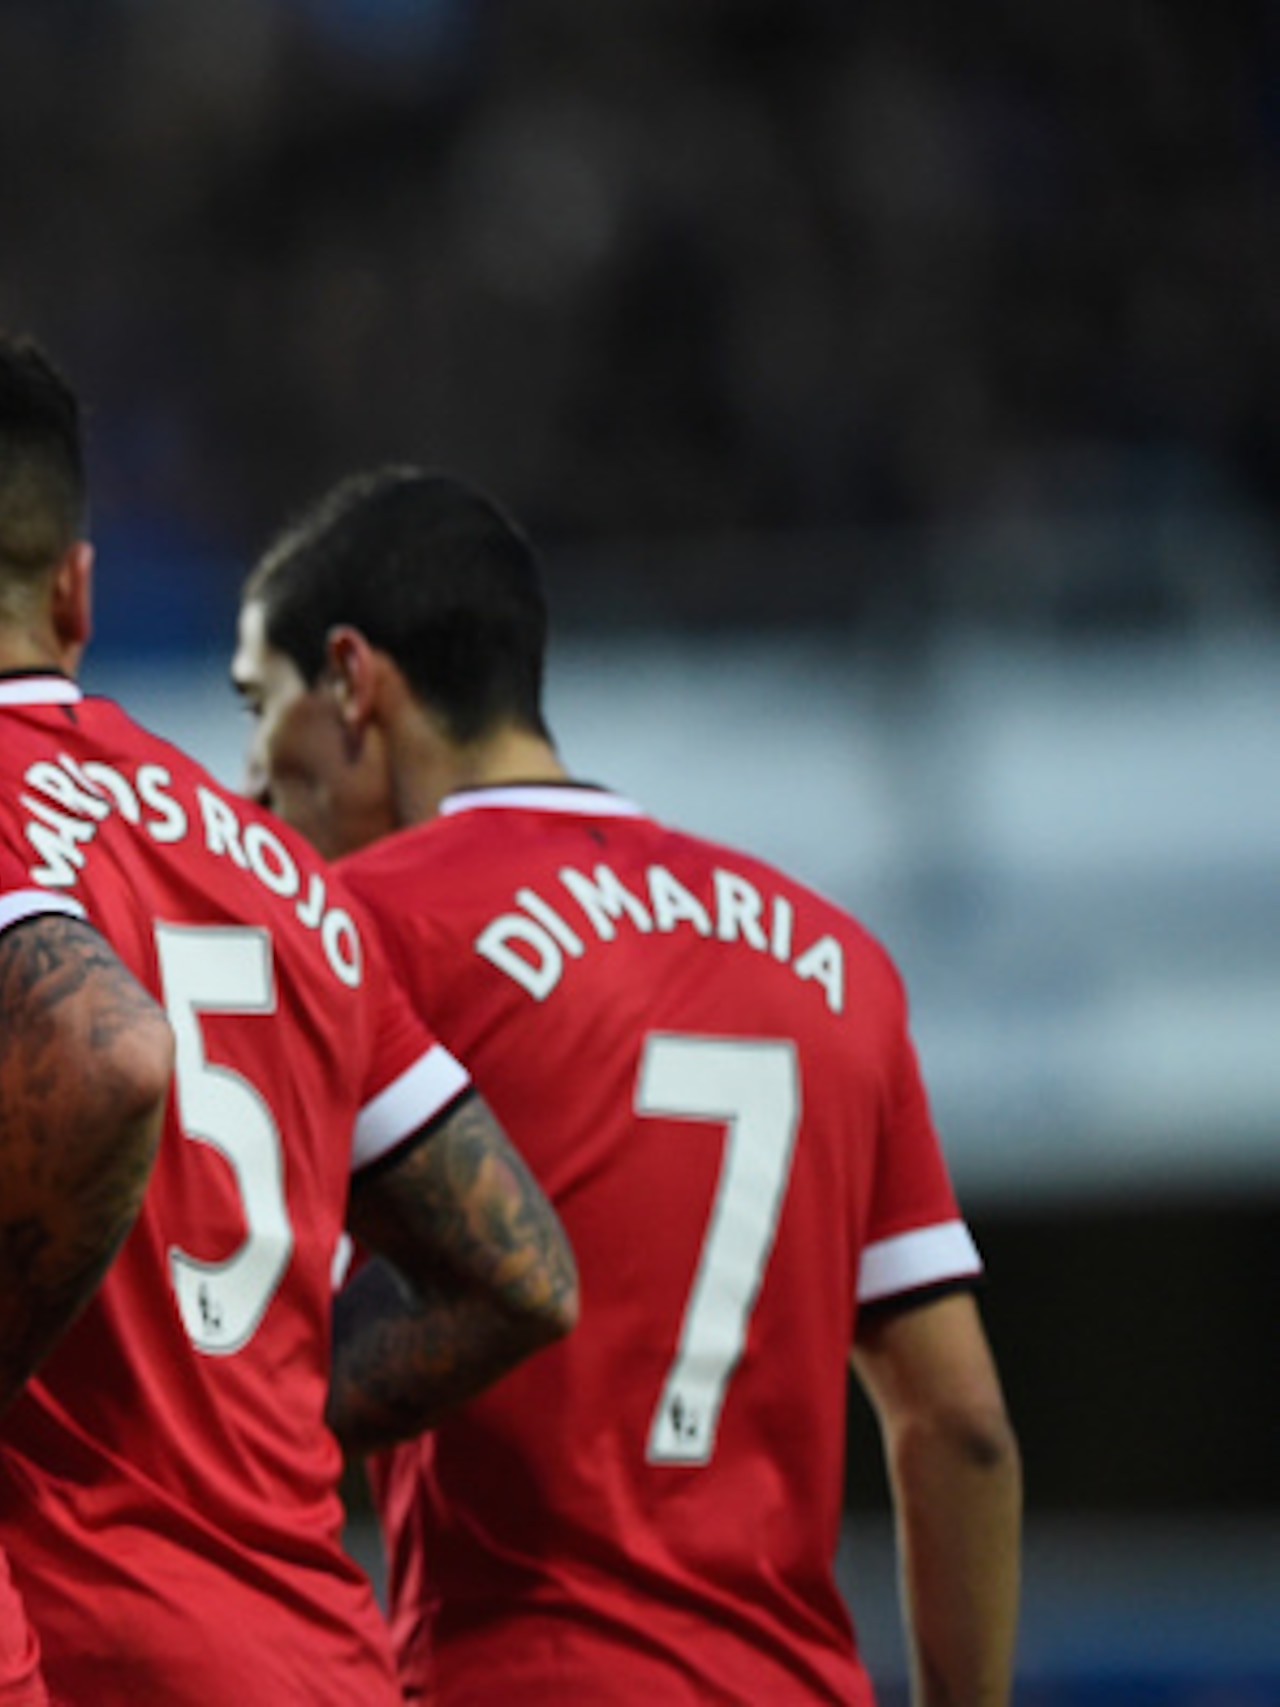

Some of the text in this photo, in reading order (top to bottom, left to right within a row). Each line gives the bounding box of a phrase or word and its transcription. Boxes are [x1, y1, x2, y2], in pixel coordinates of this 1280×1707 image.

[195, 784, 363, 988] ROJO
[474, 863, 844, 1014] DI MARIA
[153, 918, 295, 1355] 5
[632, 1030, 802, 1466] 7
